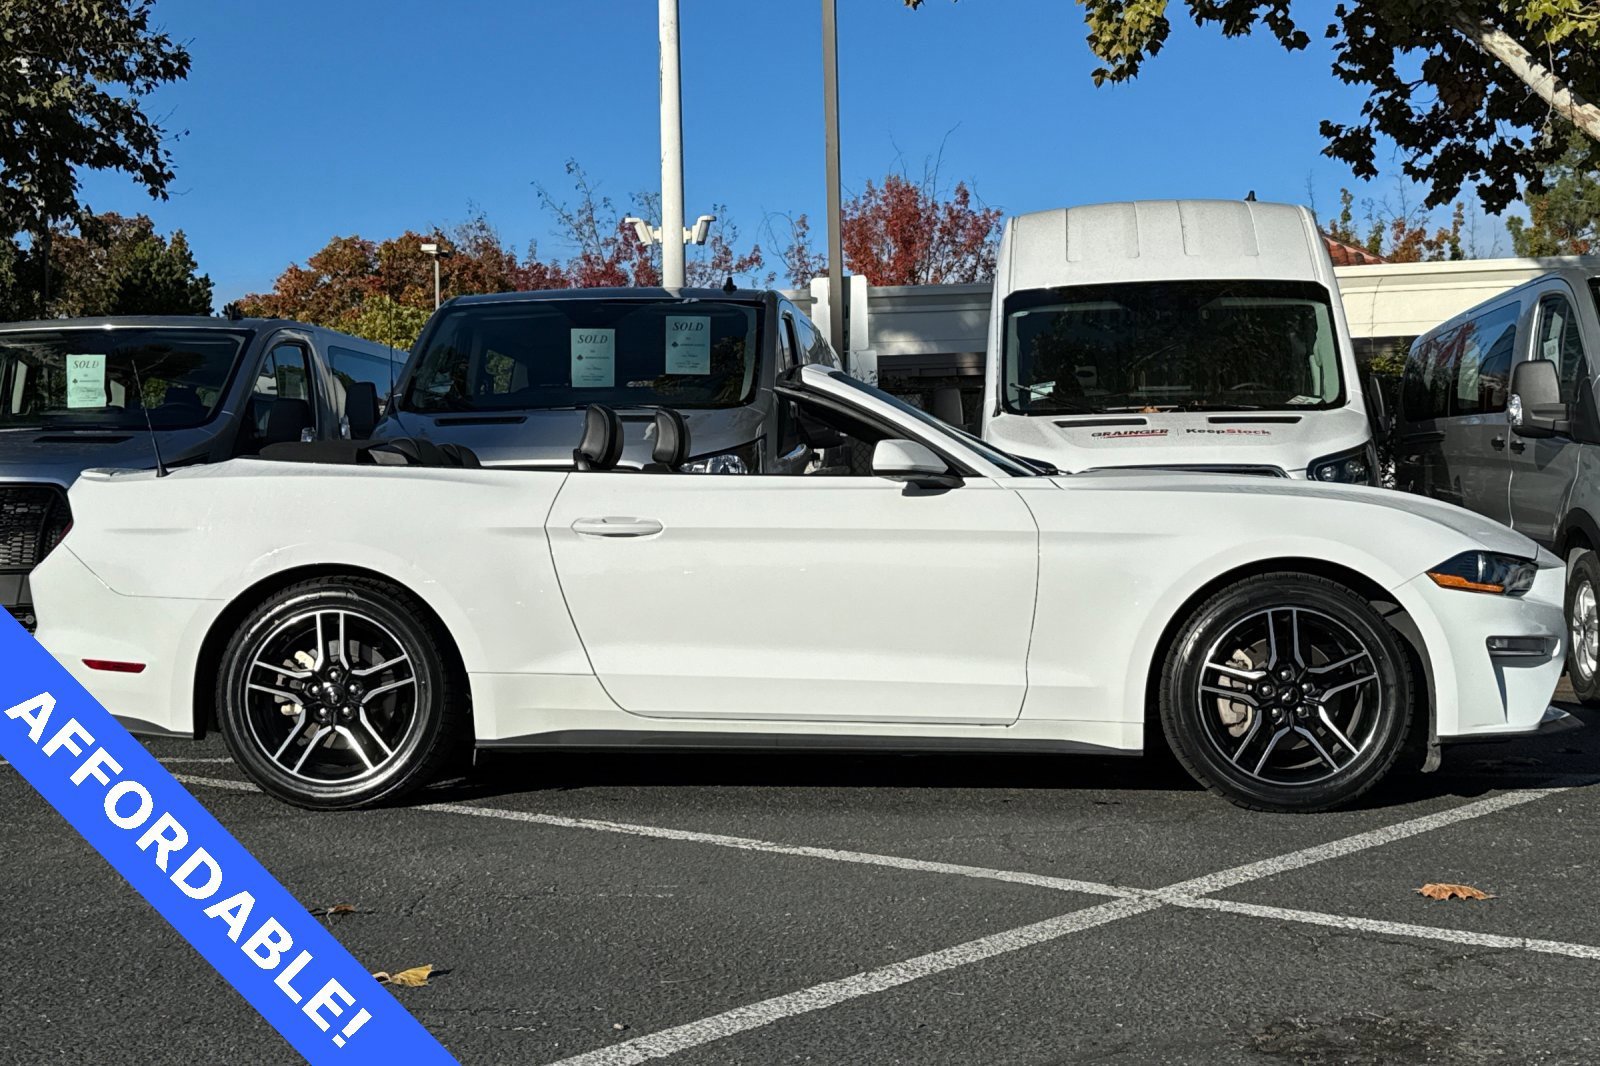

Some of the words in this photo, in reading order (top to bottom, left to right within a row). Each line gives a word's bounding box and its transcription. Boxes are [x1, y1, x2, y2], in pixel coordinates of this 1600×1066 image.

[672, 321, 704, 331] SOLD
[577, 334, 608, 344] SOLD
[73, 360, 99, 368] SOLD
[1091, 429, 1169, 437] GRAINGER
